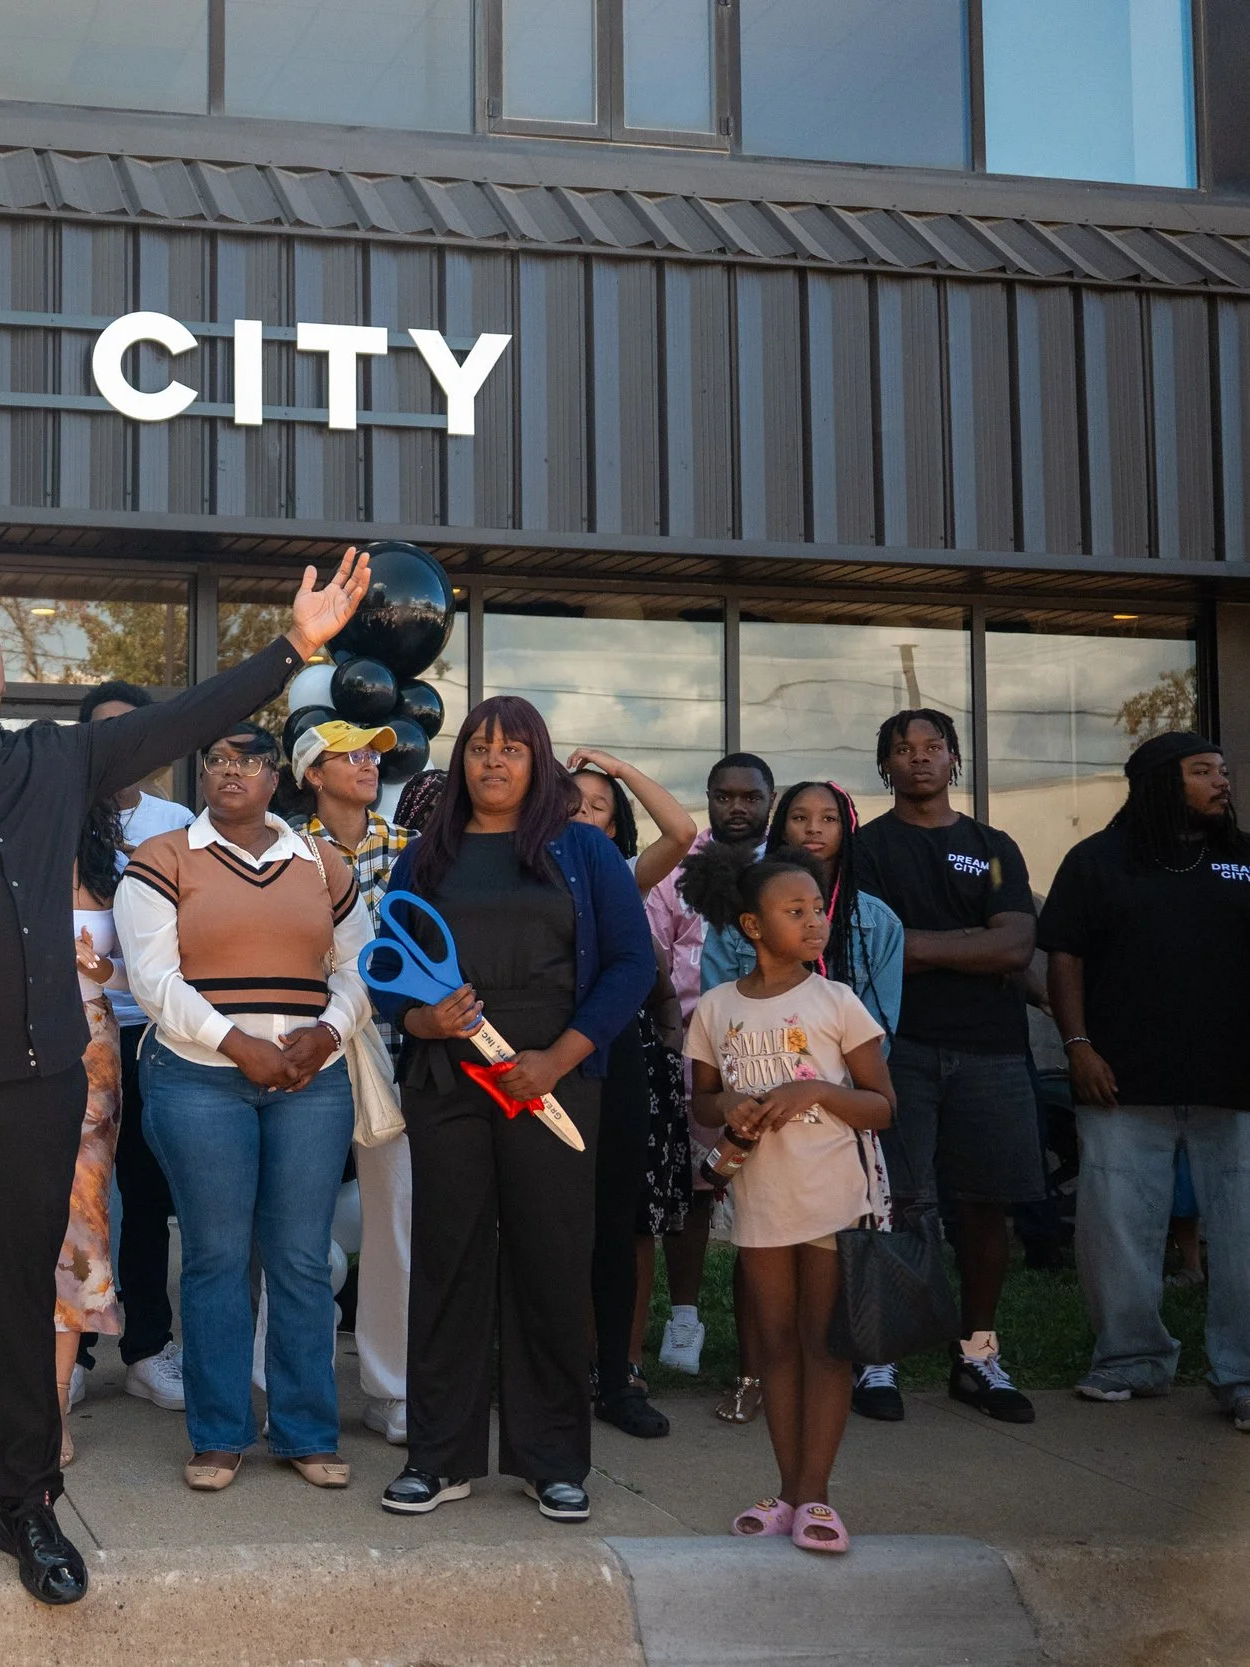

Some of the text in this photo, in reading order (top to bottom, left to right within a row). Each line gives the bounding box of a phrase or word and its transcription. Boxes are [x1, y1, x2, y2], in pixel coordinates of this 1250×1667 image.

[91, 311, 512, 437] CITY
[948, 853, 990, 870] DREAM
[954, 862, 983, 876] CITY
[1211, 863, 1250, 873] DREA
[1221, 871, 1250, 882] CITY
[481, 1029, 496, 1047] INC.
[736, 1056, 796, 1090] TOWN
[542, 1095, 562, 1120] GREA
